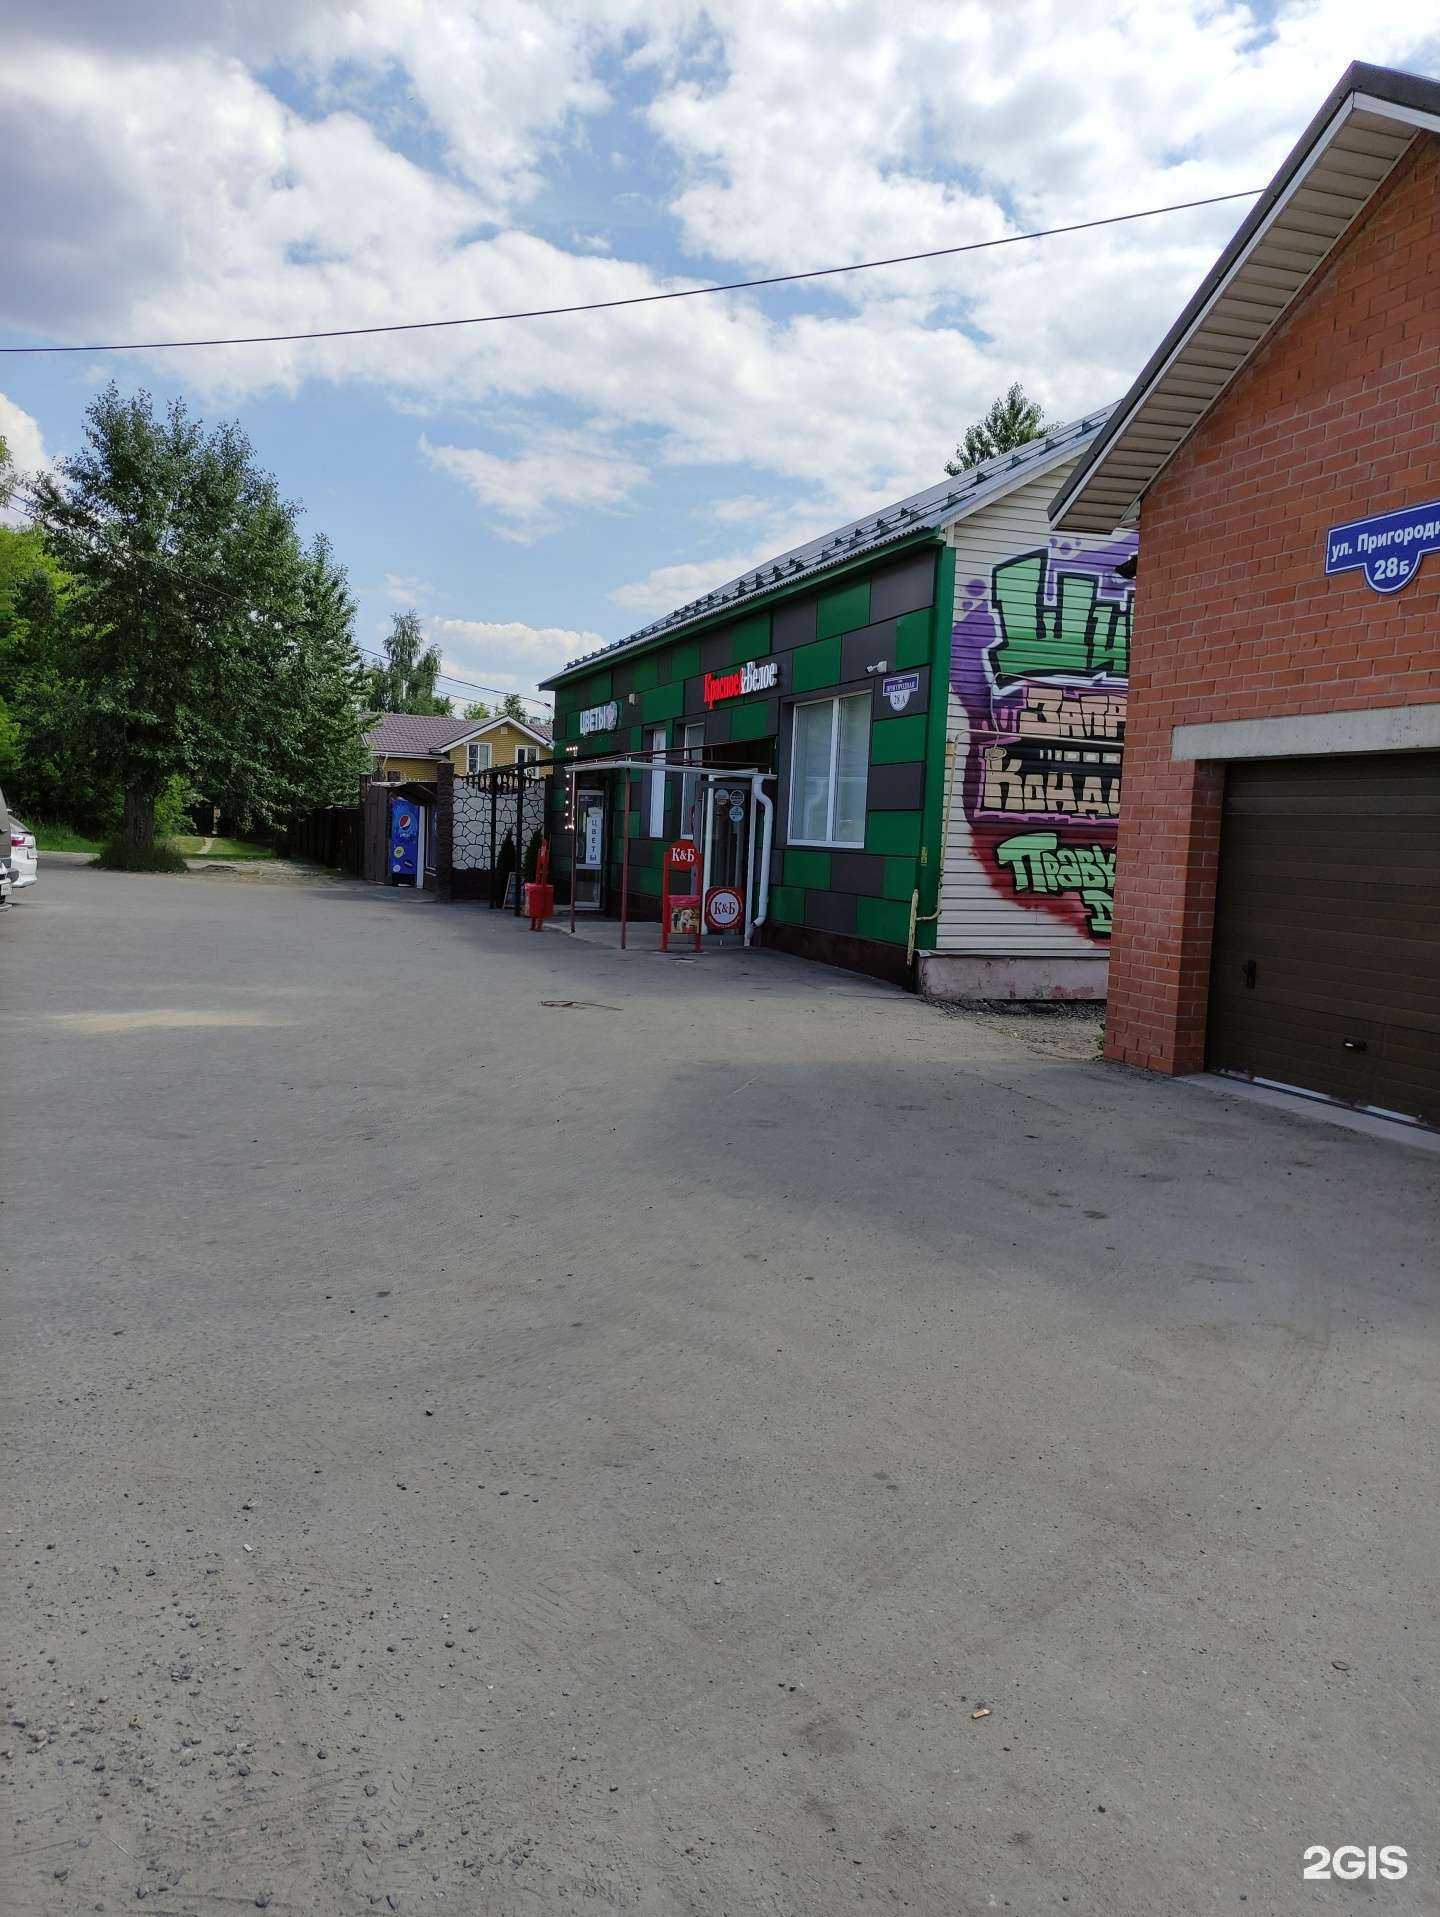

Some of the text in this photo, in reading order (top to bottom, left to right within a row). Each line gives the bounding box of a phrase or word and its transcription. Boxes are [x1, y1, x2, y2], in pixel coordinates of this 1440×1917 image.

[1331, 542, 1352, 562] ул.
[671, 847, 695, 862] К&Б
[713, 901, 736, 915] К&Б
